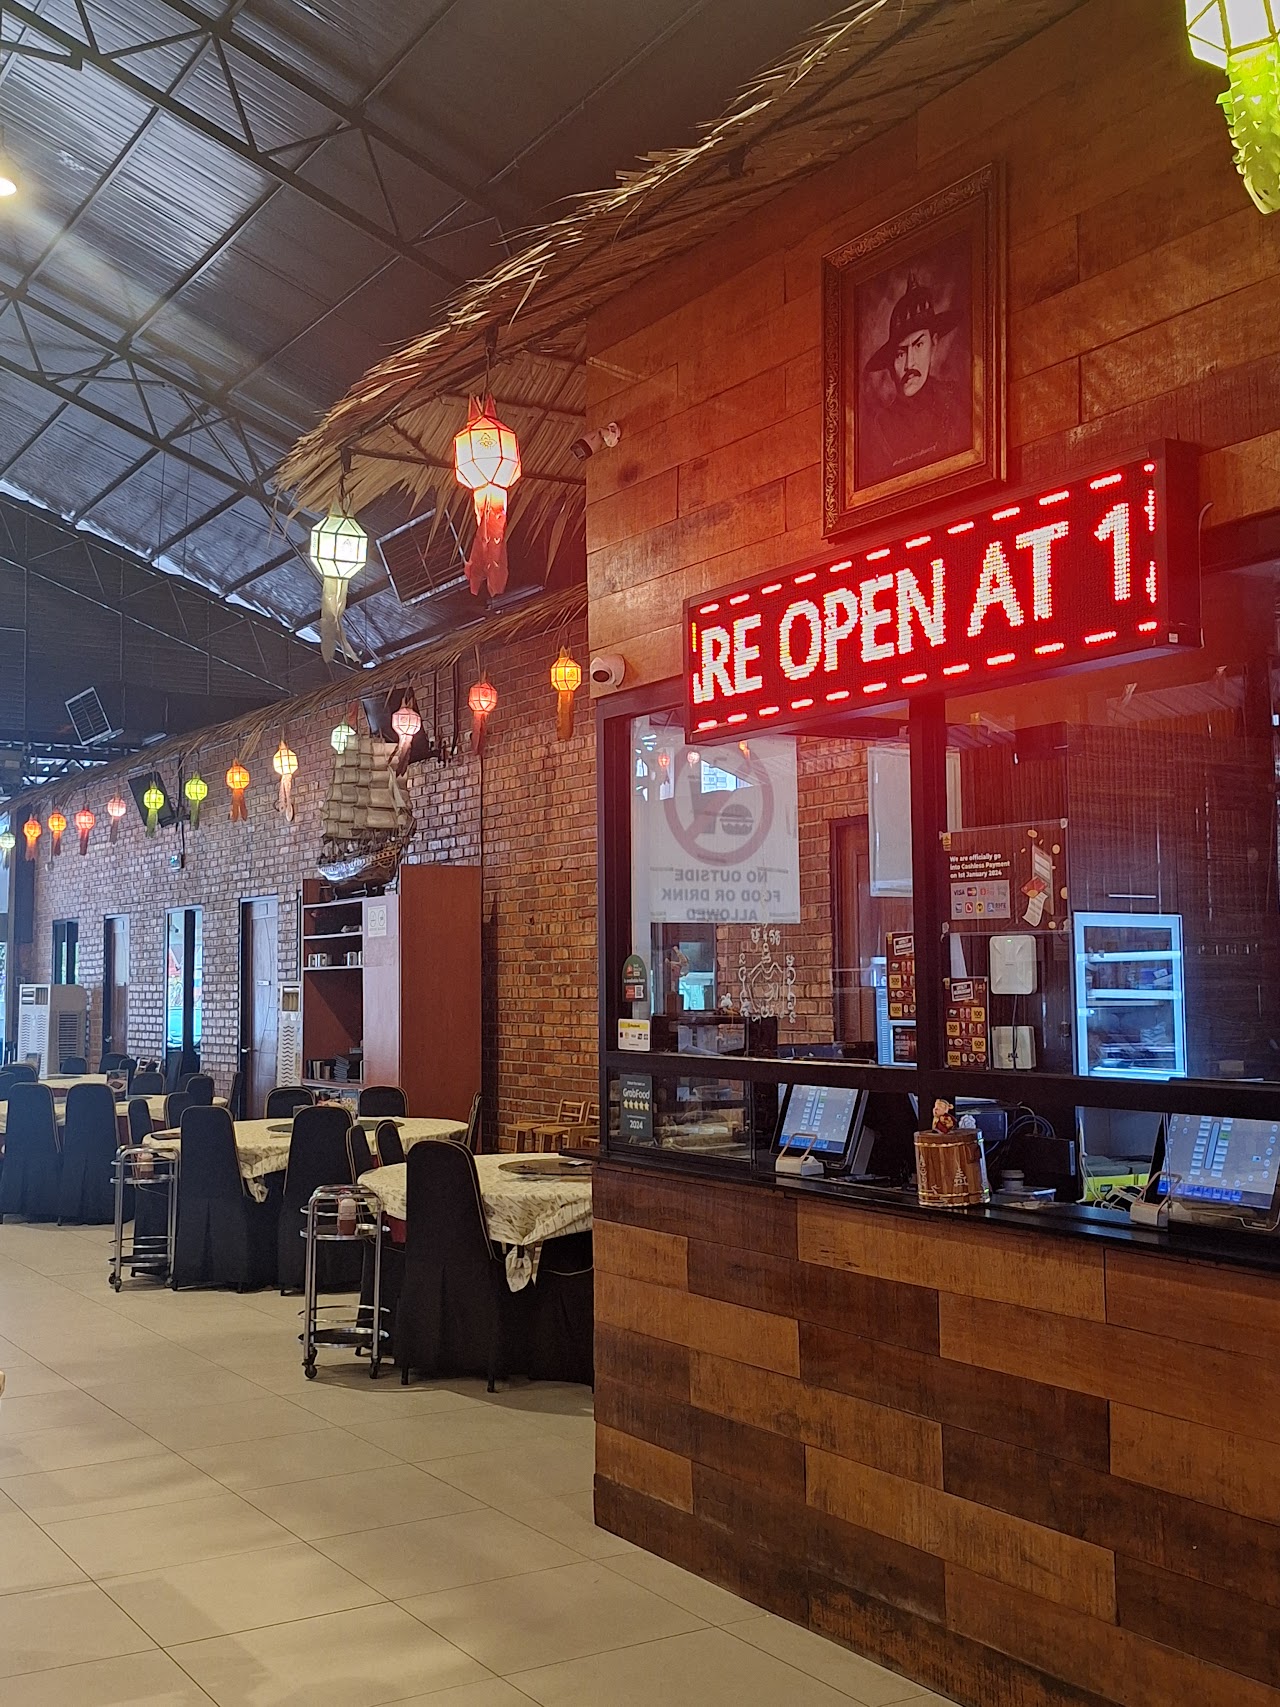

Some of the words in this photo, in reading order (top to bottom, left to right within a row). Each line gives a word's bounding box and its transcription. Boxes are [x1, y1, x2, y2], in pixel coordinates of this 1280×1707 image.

[693, 613, 762, 705] RE
[778, 559, 946, 680] OPEN
[966, 521, 1069, 637] AT
[1094, 502, 1131, 601] 1
[985, 861, 1010, 869] Payment
[622, 1088, 650, 1100] GrabFood
[629, 1120, 643, 1129] 2024
